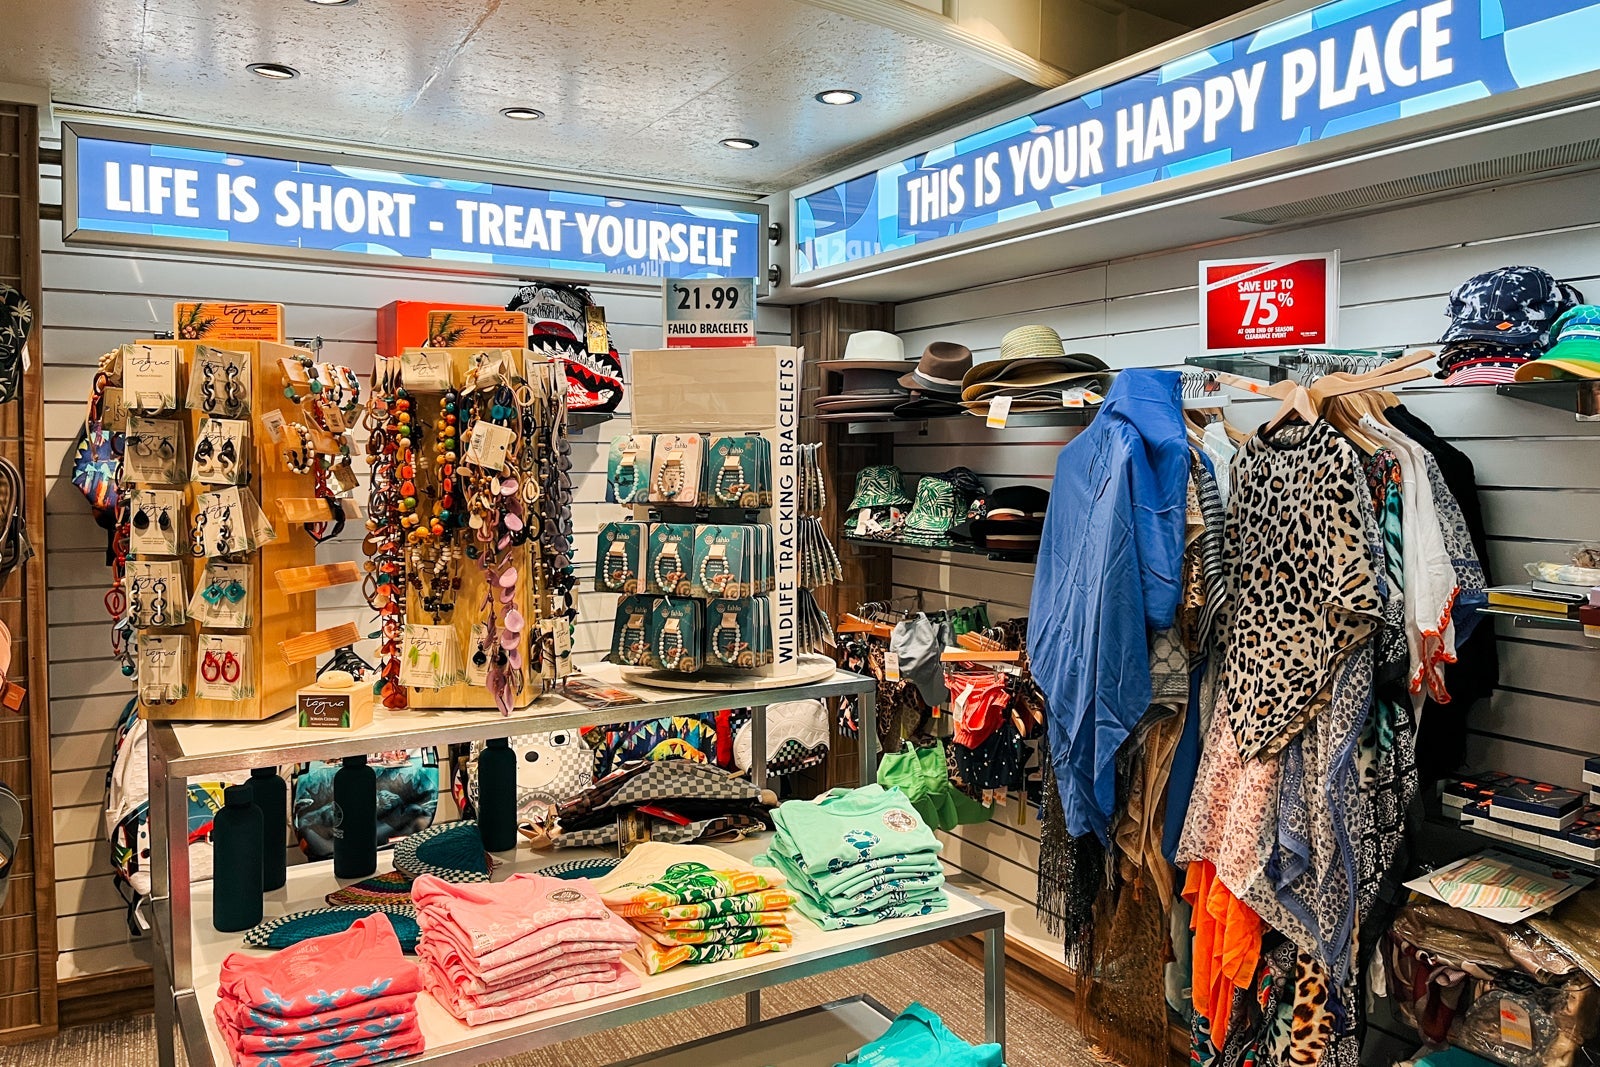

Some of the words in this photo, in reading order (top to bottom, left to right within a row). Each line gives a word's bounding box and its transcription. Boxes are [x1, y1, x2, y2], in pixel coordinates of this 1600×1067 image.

[907, 163, 965, 226] THIS
[974, 151, 1001, 207] IS
[1009, 118, 1104, 196] YOUR
[1116, 61, 1267, 168] HAPPY
[1282, 0, 1453, 121] PLACE
[105, 161, 199, 218] LIFE
[216, 173, 260, 223] IS
[274, 180, 416, 238] SHORT
[456, 199, 566, 251] TREAT
[574, 212, 738, 267] YOURSELF
[1238, 281, 1261, 293] SAVE
[1264, 280, 1278, 291] UP
[1281, 279, 1294, 290] TO
[672, 283, 739, 310] $21.99
[219, 304, 269, 324] tagua
[1239, 291, 1294, 327] 75%
[467, 314, 515, 334] tagua
[668, 323, 697, 334] FAHLO
[700, 323, 749, 334] BRACELETS
[128, 357, 170, 372] tagua
[779, 358, 794, 467] BRACELETS
[779, 475, 794, 573] TRACKING
[668, 533, 682, 541] fahlo
[715, 535, 730, 543] fahlo
[779, 581, 794, 664] WILDLIFE
[142, 648, 176, 664] tagua
[302, 697, 345, 715] tagua
